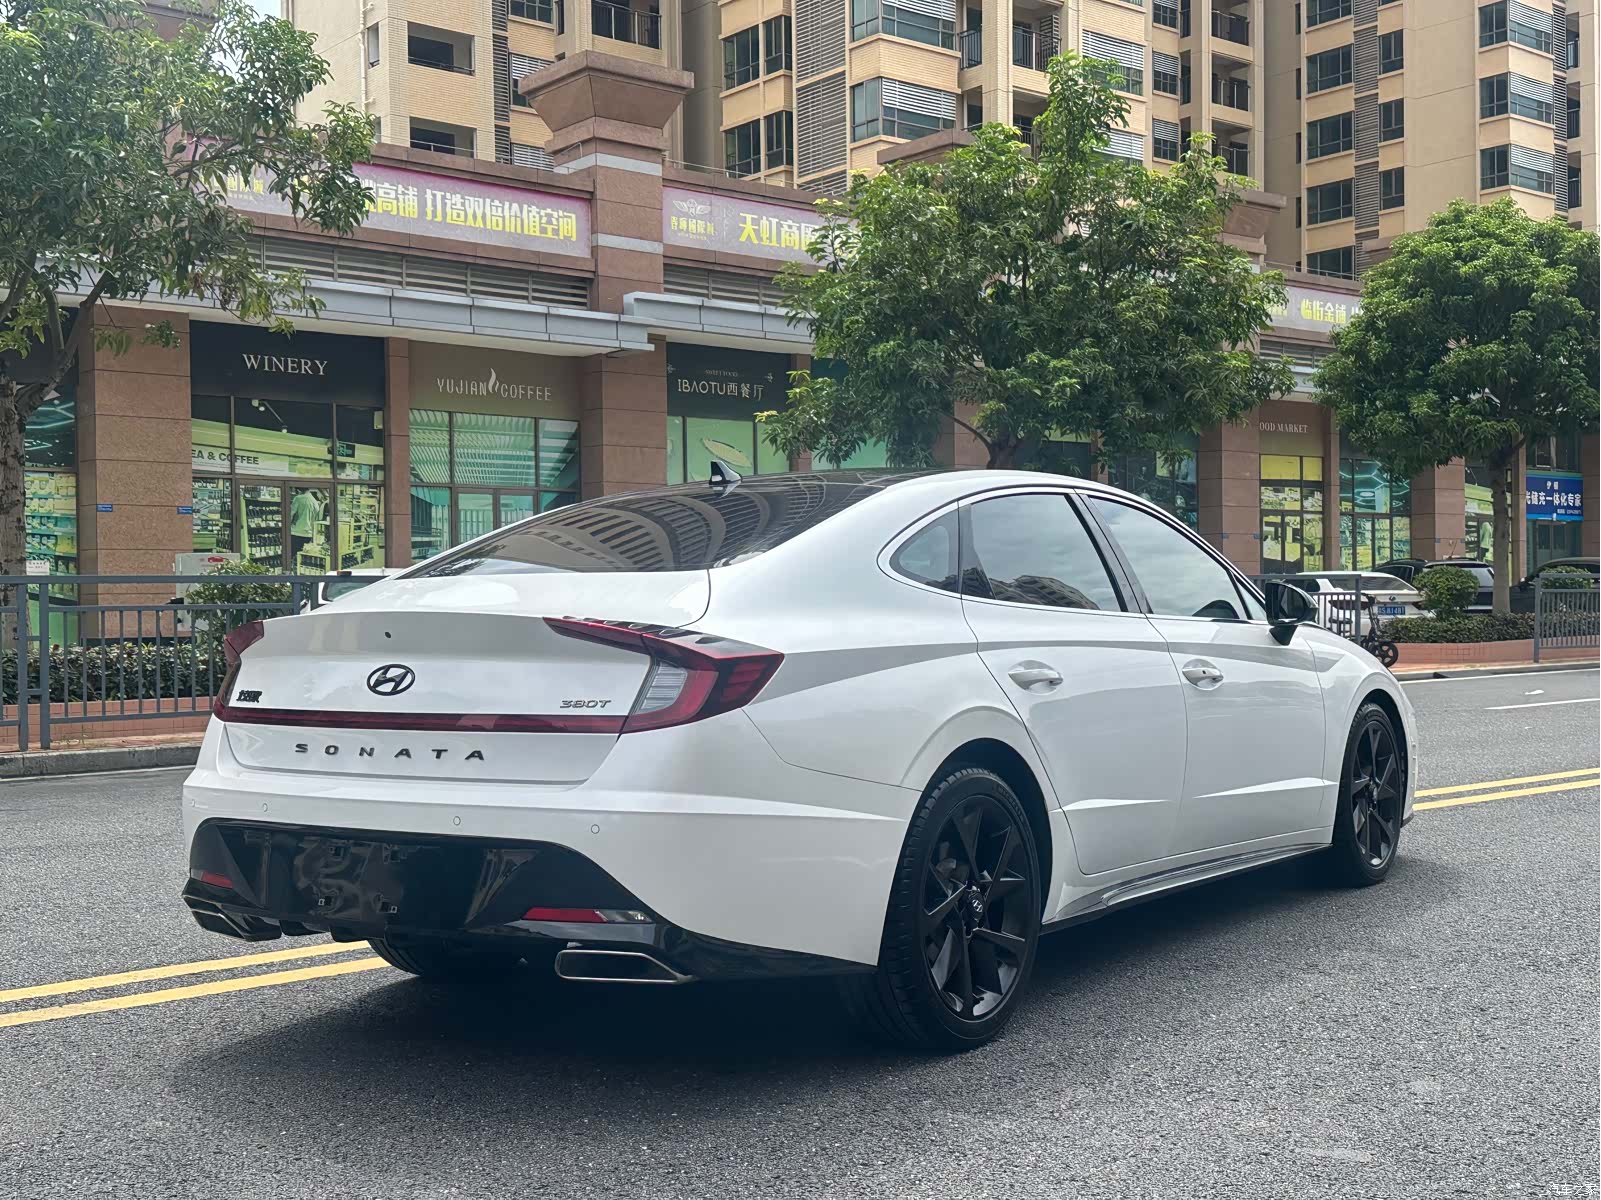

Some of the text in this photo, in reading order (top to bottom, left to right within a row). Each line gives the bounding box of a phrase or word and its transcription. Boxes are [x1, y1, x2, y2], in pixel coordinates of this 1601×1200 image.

[425, 187, 577, 241] 打造双倍价值空间
[242, 353, 328, 376] WINERY
[436, 377, 552, 401] YUJIAN COFFEE
[1260, 422, 1308, 433] OOD MARKET
[192, 449, 259, 464] EA & COFFEE
[560, 699, 612, 709] 380T
[294, 742, 486, 762] SONATA
